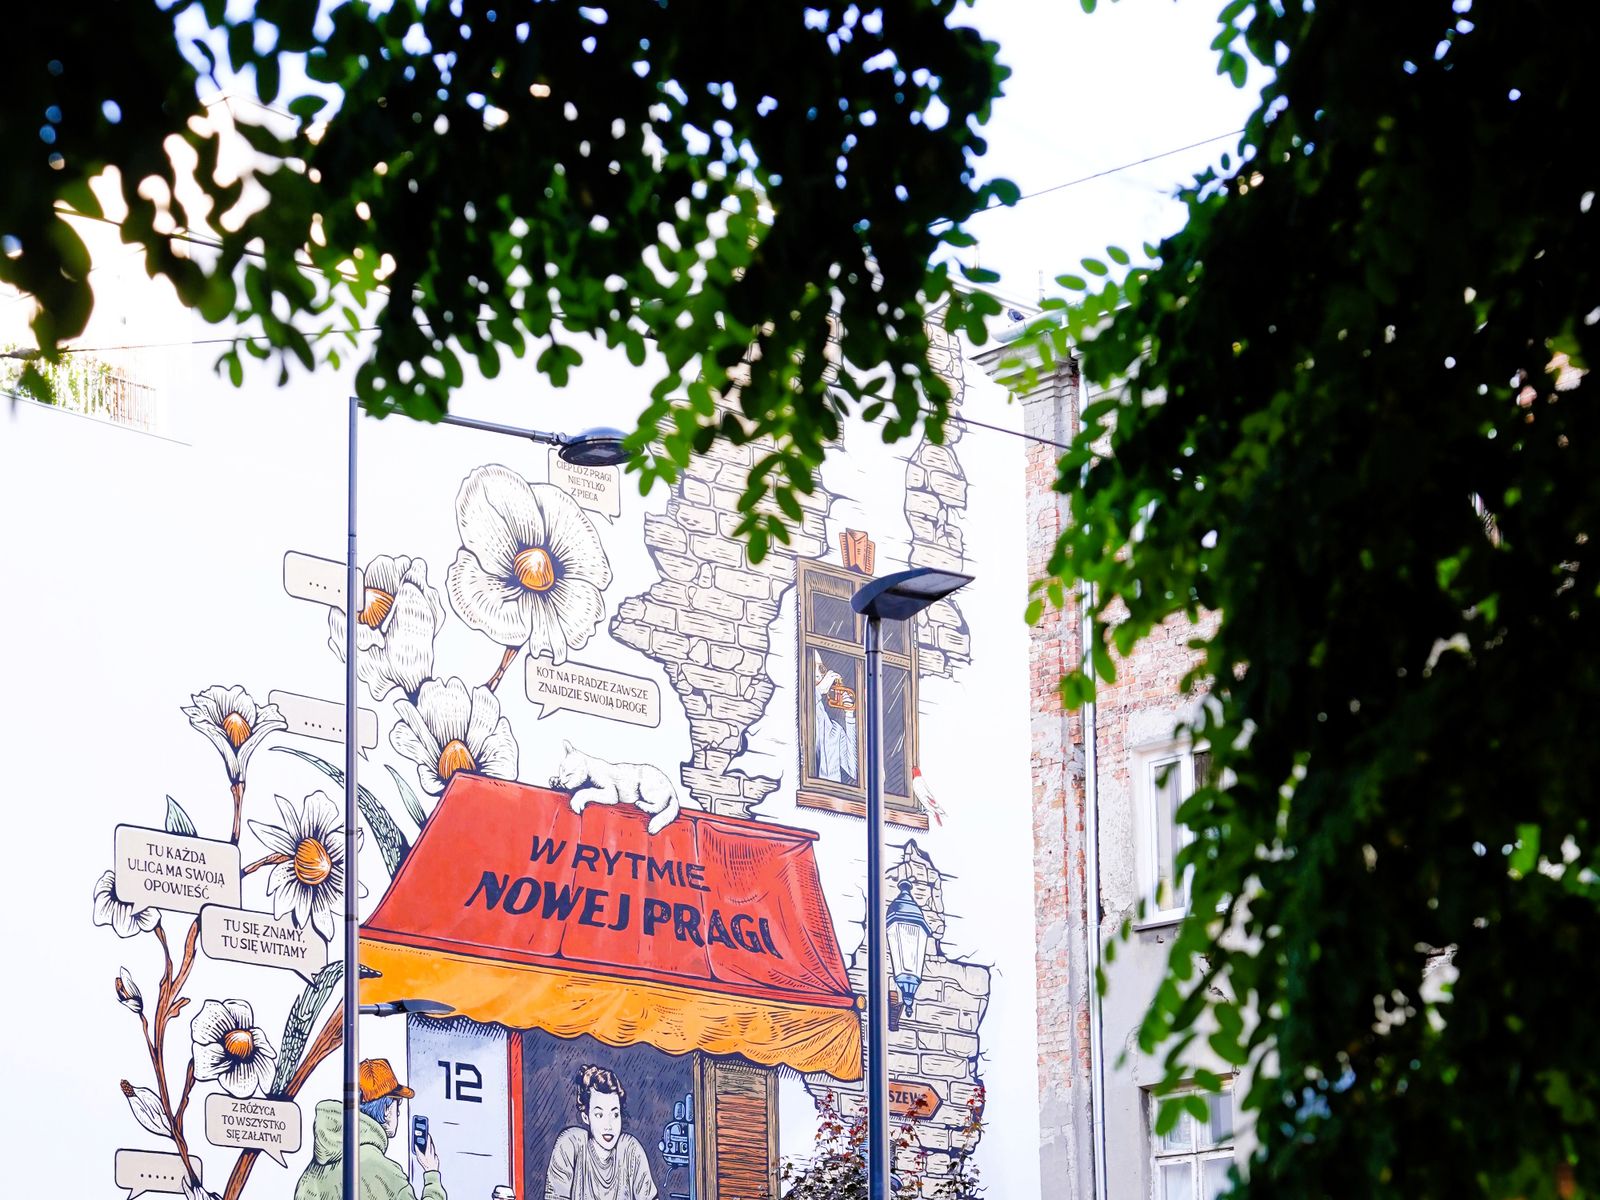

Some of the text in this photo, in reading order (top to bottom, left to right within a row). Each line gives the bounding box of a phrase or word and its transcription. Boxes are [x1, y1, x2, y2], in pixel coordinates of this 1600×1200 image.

[567, 475, 606, 492] NIE TYLKO
[590, 469, 612, 483] PRAGI
[570, 487, 599, 502] Z PIECA
[536, 666, 649, 700] KOT NA PRADZE ZAWSZE
[538, 681, 648, 716] ZNAJDZIE SWOJĄ DROGĘ
[146, 843, 207, 865] TU KAŻDA
[529, 835, 711, 893] W RYTMIE
[127, 857, 225, 888] ULICA MA SWOJĄ
[143, 878, 210, 900] OPOWIEŚĆ
[464, 870, 784, 960] NOWEJ PRAGI
[223, 918, 241, 932] TU
[242, 922, 260, 938] SIĘ
[221, 935, 307, 959] TU SIĘ WITAMY
[437, 1060, 483, 1104] 12
[231, 1101, 276, 1117] Z RÓŻYCA
[222, 1115, 286, 1131] TO WSZYSTKO
[226, 1128, 282, 1144] SIĘ ZAŁATWI
